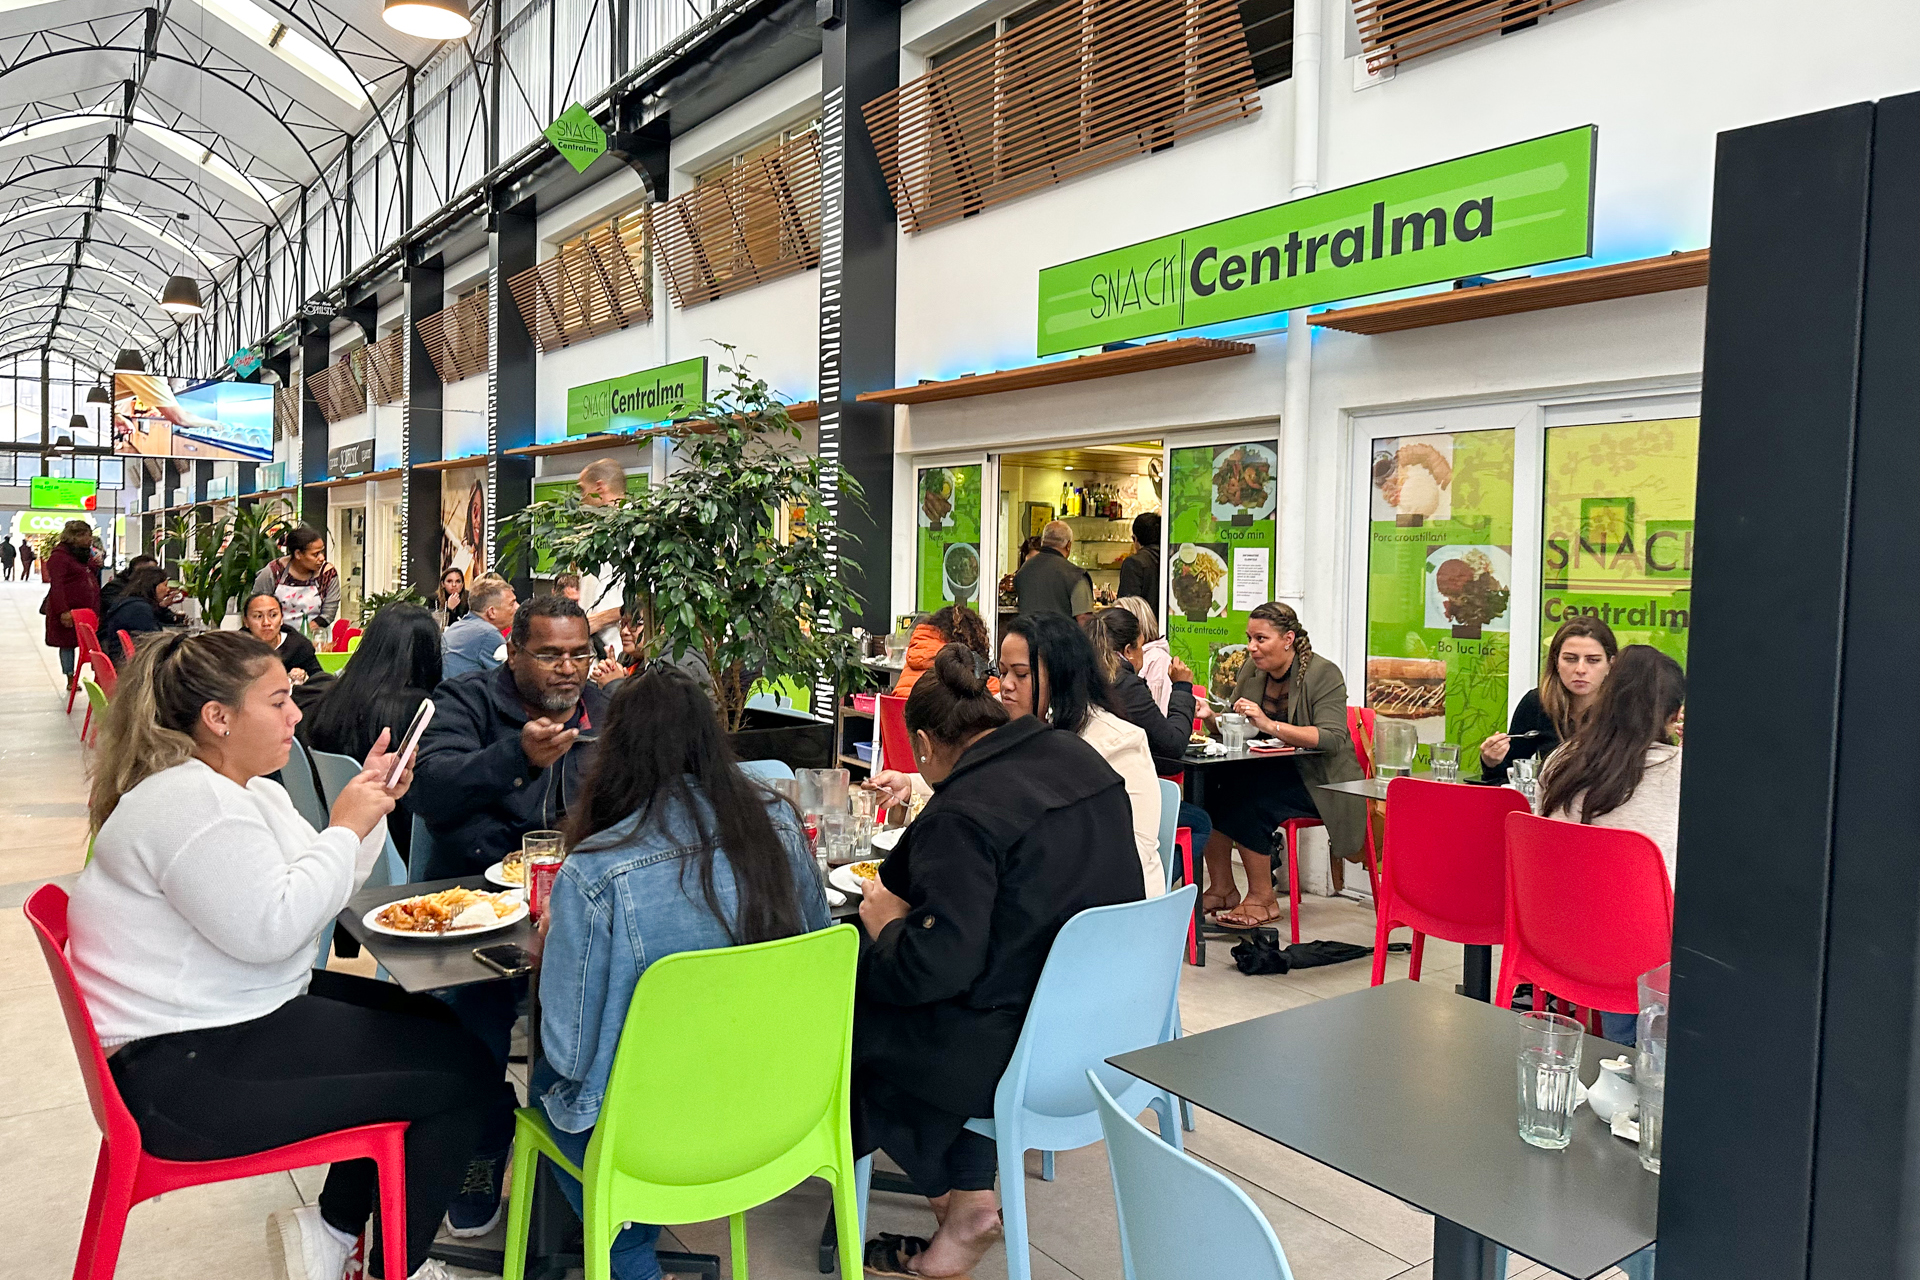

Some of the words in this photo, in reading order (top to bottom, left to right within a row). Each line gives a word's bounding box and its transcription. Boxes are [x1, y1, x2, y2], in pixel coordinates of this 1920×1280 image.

[557, 119, 598, 141] SNACK
[558, 141, 599, 153] Centralma
[1090, 253, 1176, 320] SNACK
[1190, 195, 1495, 297] Centralma
[582, 391, 609, 420] SNACK
[611, 379, 684, 414] Centralma
[1220, 529, 1245, 540] Chao
[1247, 528, 1265, 539] min
[1373, 532, 1392, 542] Porc
[1394, 532, 1447, 542] croustillant
[1544, 597, 1690, 628] Centralm
[1169, 623, 1186, 634] Noix
[1187, 625, 1229, 636] d'entrecôte
[1438, 641, 1453, 653] Bo
[1456, 641, 1475, 655] luc
